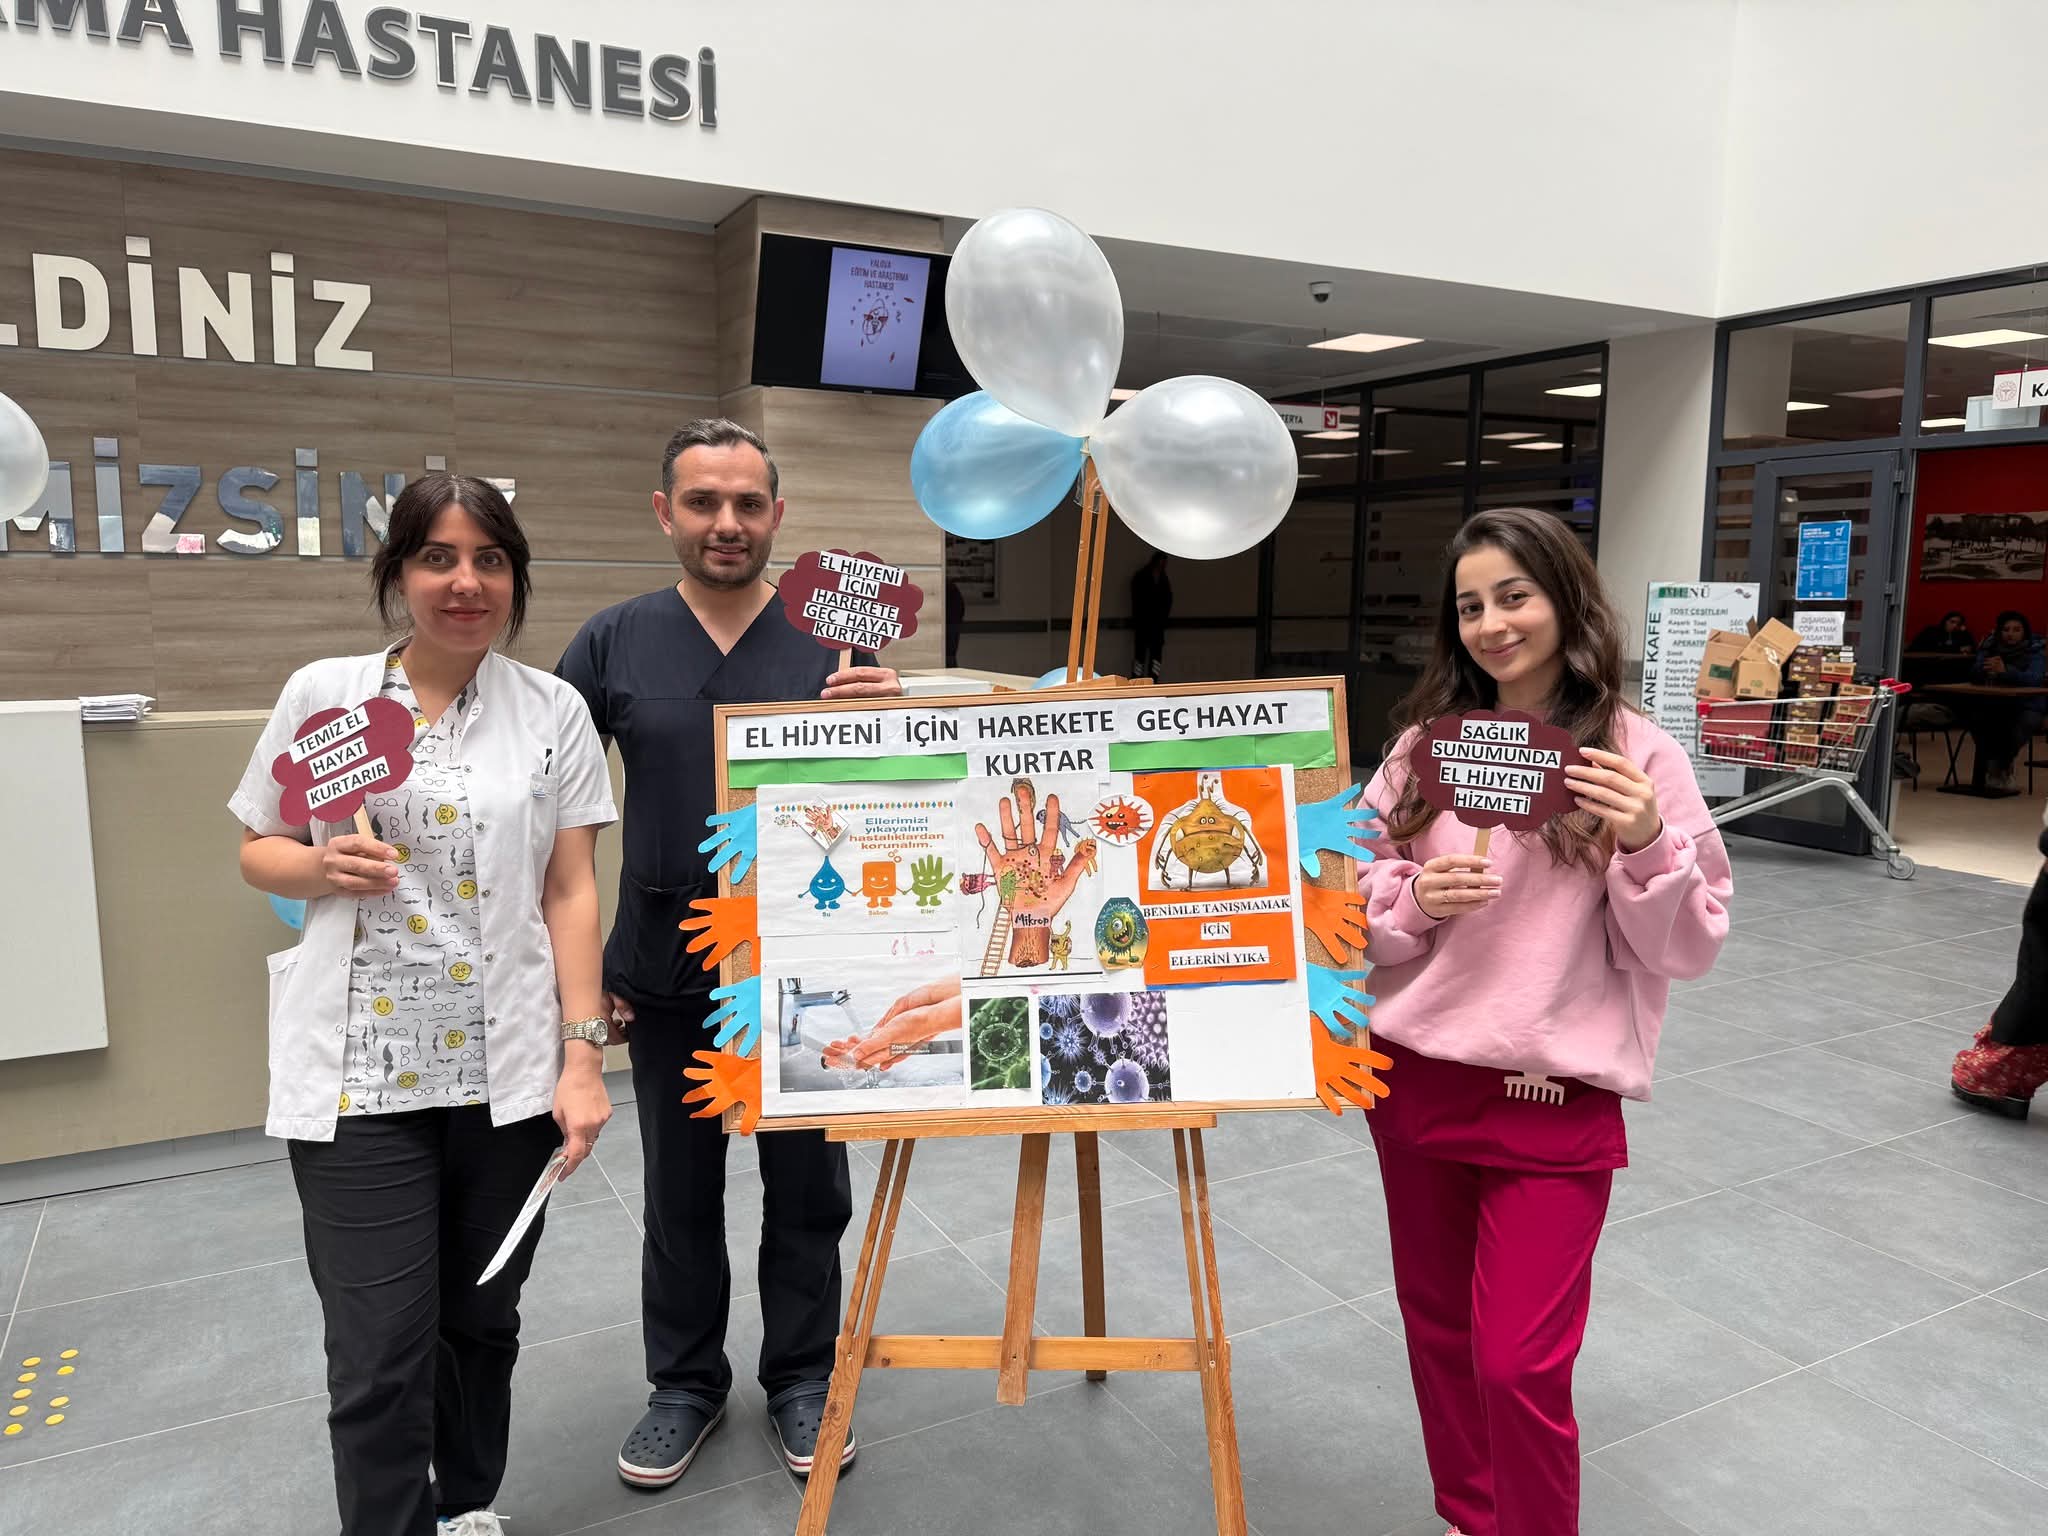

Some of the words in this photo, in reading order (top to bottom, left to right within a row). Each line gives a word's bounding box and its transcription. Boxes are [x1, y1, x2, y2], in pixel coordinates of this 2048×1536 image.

[218, 0, 717, 127] HASTANESİ
[0, 235, 374, 372] DİNİZ
[819, 555, 835, 570] EL
[840, 559, 901, 584] HİJYENİ
[845, 575, 877, 597] İÇİN
[816, 589, 897, 619] HAREKETE
[806, 604, 838, 622] GEÇ
[845, 613, 900, 637] HAYAT
[815, 622, 879, 648] KURTAR
[1646, 612, 1661, 662] KAFE
[297, 723, 344, 754] TEMİZ
[345, 713, 364, 729] EL
[746, 727, 774, 748] EL
[782, 718, 881, 747] HİJYENİ
[905, 715, 958, 747] İÇİN
[978, 710, 1114, 739] HAREKETE
[1137, 707, 1190, 734] GEÇ
[1197, 702, 1288, 729] HAYAT
[1463, 723, 1527, 742] SAĞLIK
[313, 741, 364, 775] HAYAT
[985, 749, 1094, 776] KURTAR
[1433, 742, 1558, 766] SUNUMUNDA
[310, 763, 388, 805] KURTARIR
[1440, 767, 1460, 783] EL
[1467, 767, 1542, 791] HİJYENİ
[1455, 788, 1530, 813] HİZMETİ
[865, 816, 929, 825] Ellerimizi
[865, 825, 928, 834] yıkayalım
[850, 833, 944, 842] hastalıklardan
[861, 842, 933, 850] korunalım.
[1014, 913, 1049, 926] Mikrop
[1143, 904, 1200, 918] BENİMLE
[1202, 898, 1290, 913] TANIŞMAMAK
[1203, 922, 1230, 936] İÇİN
[1171, 952, 1230, 967] ELLERİNİ
[1233, 952, 1266, 965] YIKA
